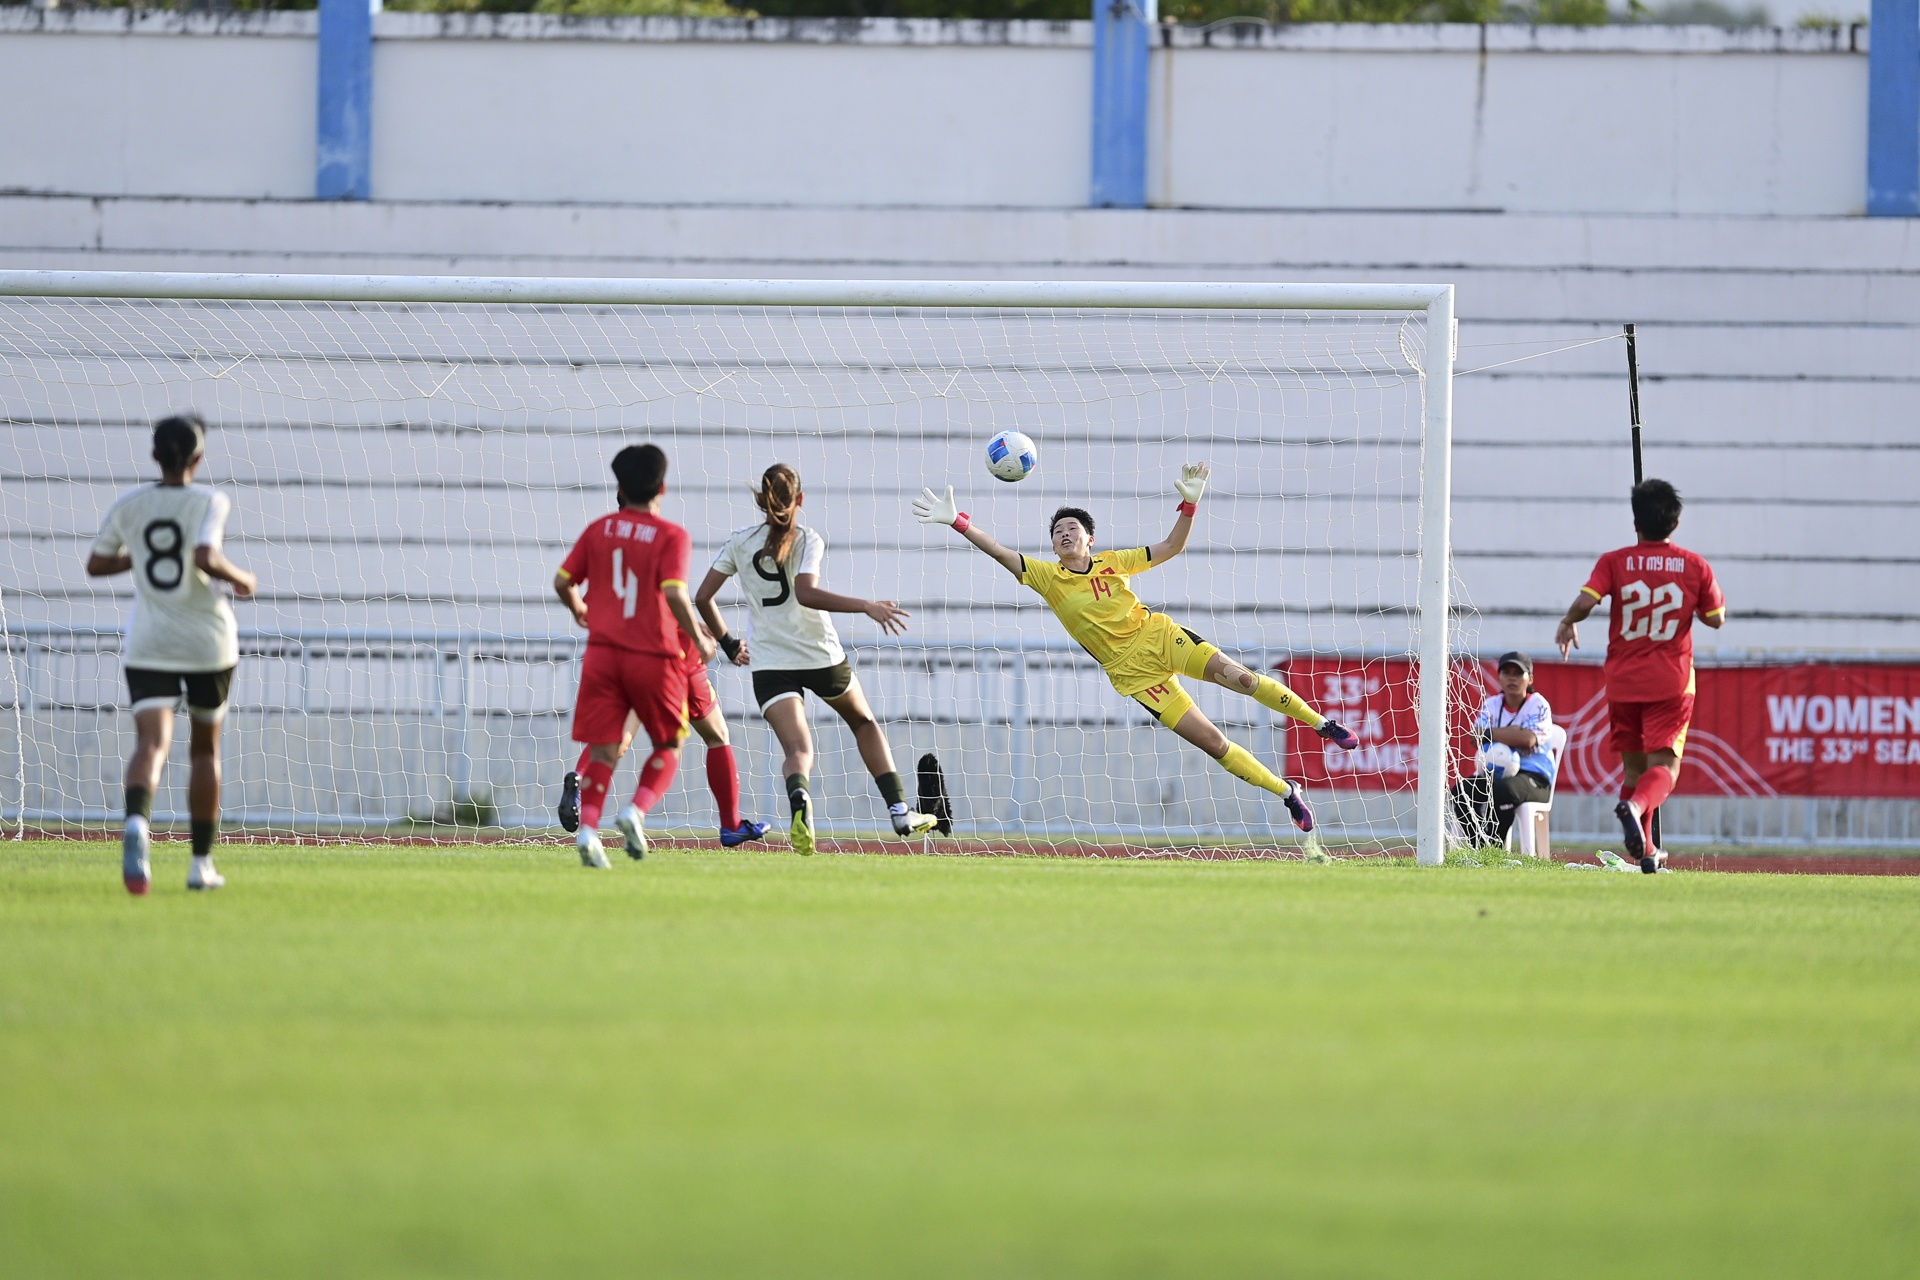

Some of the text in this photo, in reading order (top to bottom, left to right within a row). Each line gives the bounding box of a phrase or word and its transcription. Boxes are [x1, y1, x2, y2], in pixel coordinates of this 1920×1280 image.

[143, 518, 185, 592] 8
[1638, 556, 1644, 571] T
[1646, 556, 1663, 571] MY
[1665, 557, 1685, 573] ANH
[611, 547, 638, 619] 4
[752, 549, 790, 607] 9
[1090, 576, 1112, 601] 14
[1620, 580, 1684, 641] 22
[1145, 683, 1170, 704] 14
[1766, 694, 1920, 734] WOMEN
[1765, 738, 1815, 763] THE
[1821, 737, 1869, 763] 33rd
